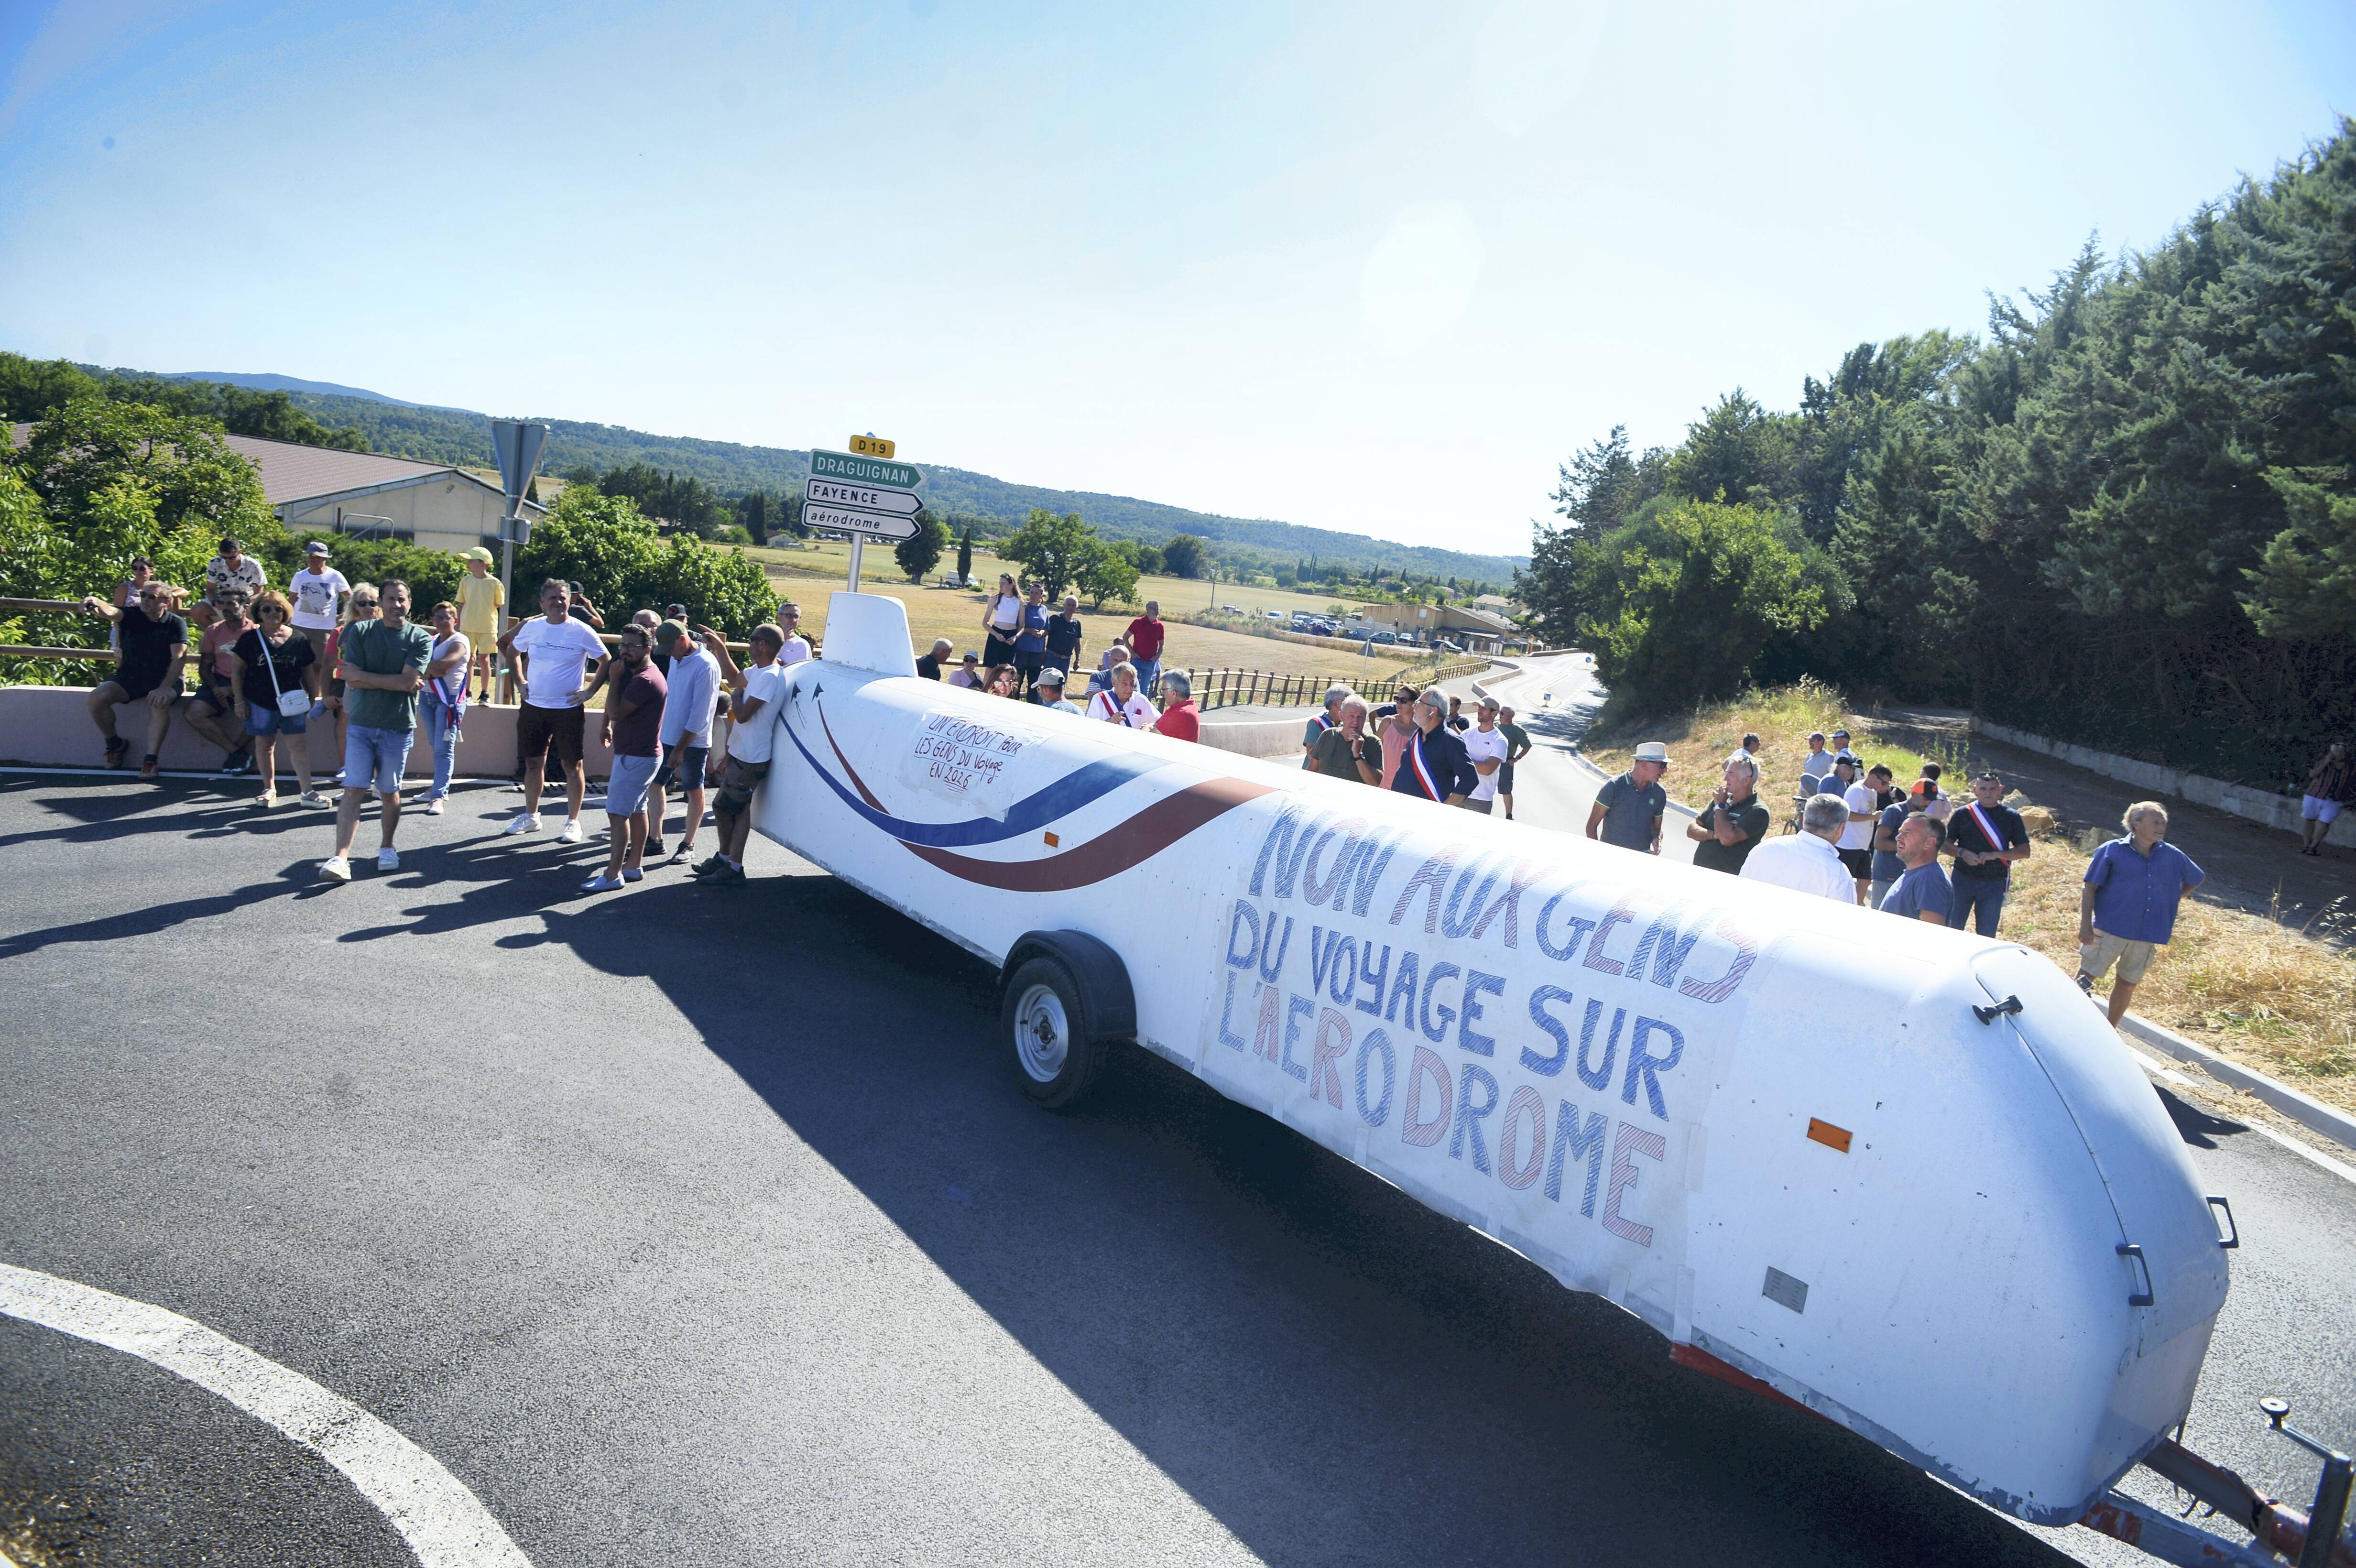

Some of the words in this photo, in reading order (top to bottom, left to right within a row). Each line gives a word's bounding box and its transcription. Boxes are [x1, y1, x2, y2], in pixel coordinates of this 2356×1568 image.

[859, 440, 866, 450] D
[871, 442, 886, 454] 19
[817, 457, 909, 483] DRAGUIGNAN
[813, 485, 878, 504] FAYENCE
[811, 512, 880, 529] aérodrome
[928, 714, 953, 732] UN
[915, 737, 934, 754] LES
[932, 741, 959, 762] GENS
[957, 750, 972, 767] DU
[929, 762, 946, 778] EN
[944, 767, 972, 788] 2026
[1248, 804, 1414, 917] NON
[1389, 843, 1563, 949] AUX
[1536, 880, 1758, 1004] GENS
[1225, 899, 1295, 984] DU
[1312, 926, 1506, 1057] VOYAGE
[1519, 985, 1684, 1122] SUR
[1219, 970, 1666, 1248] L'AERODROME
